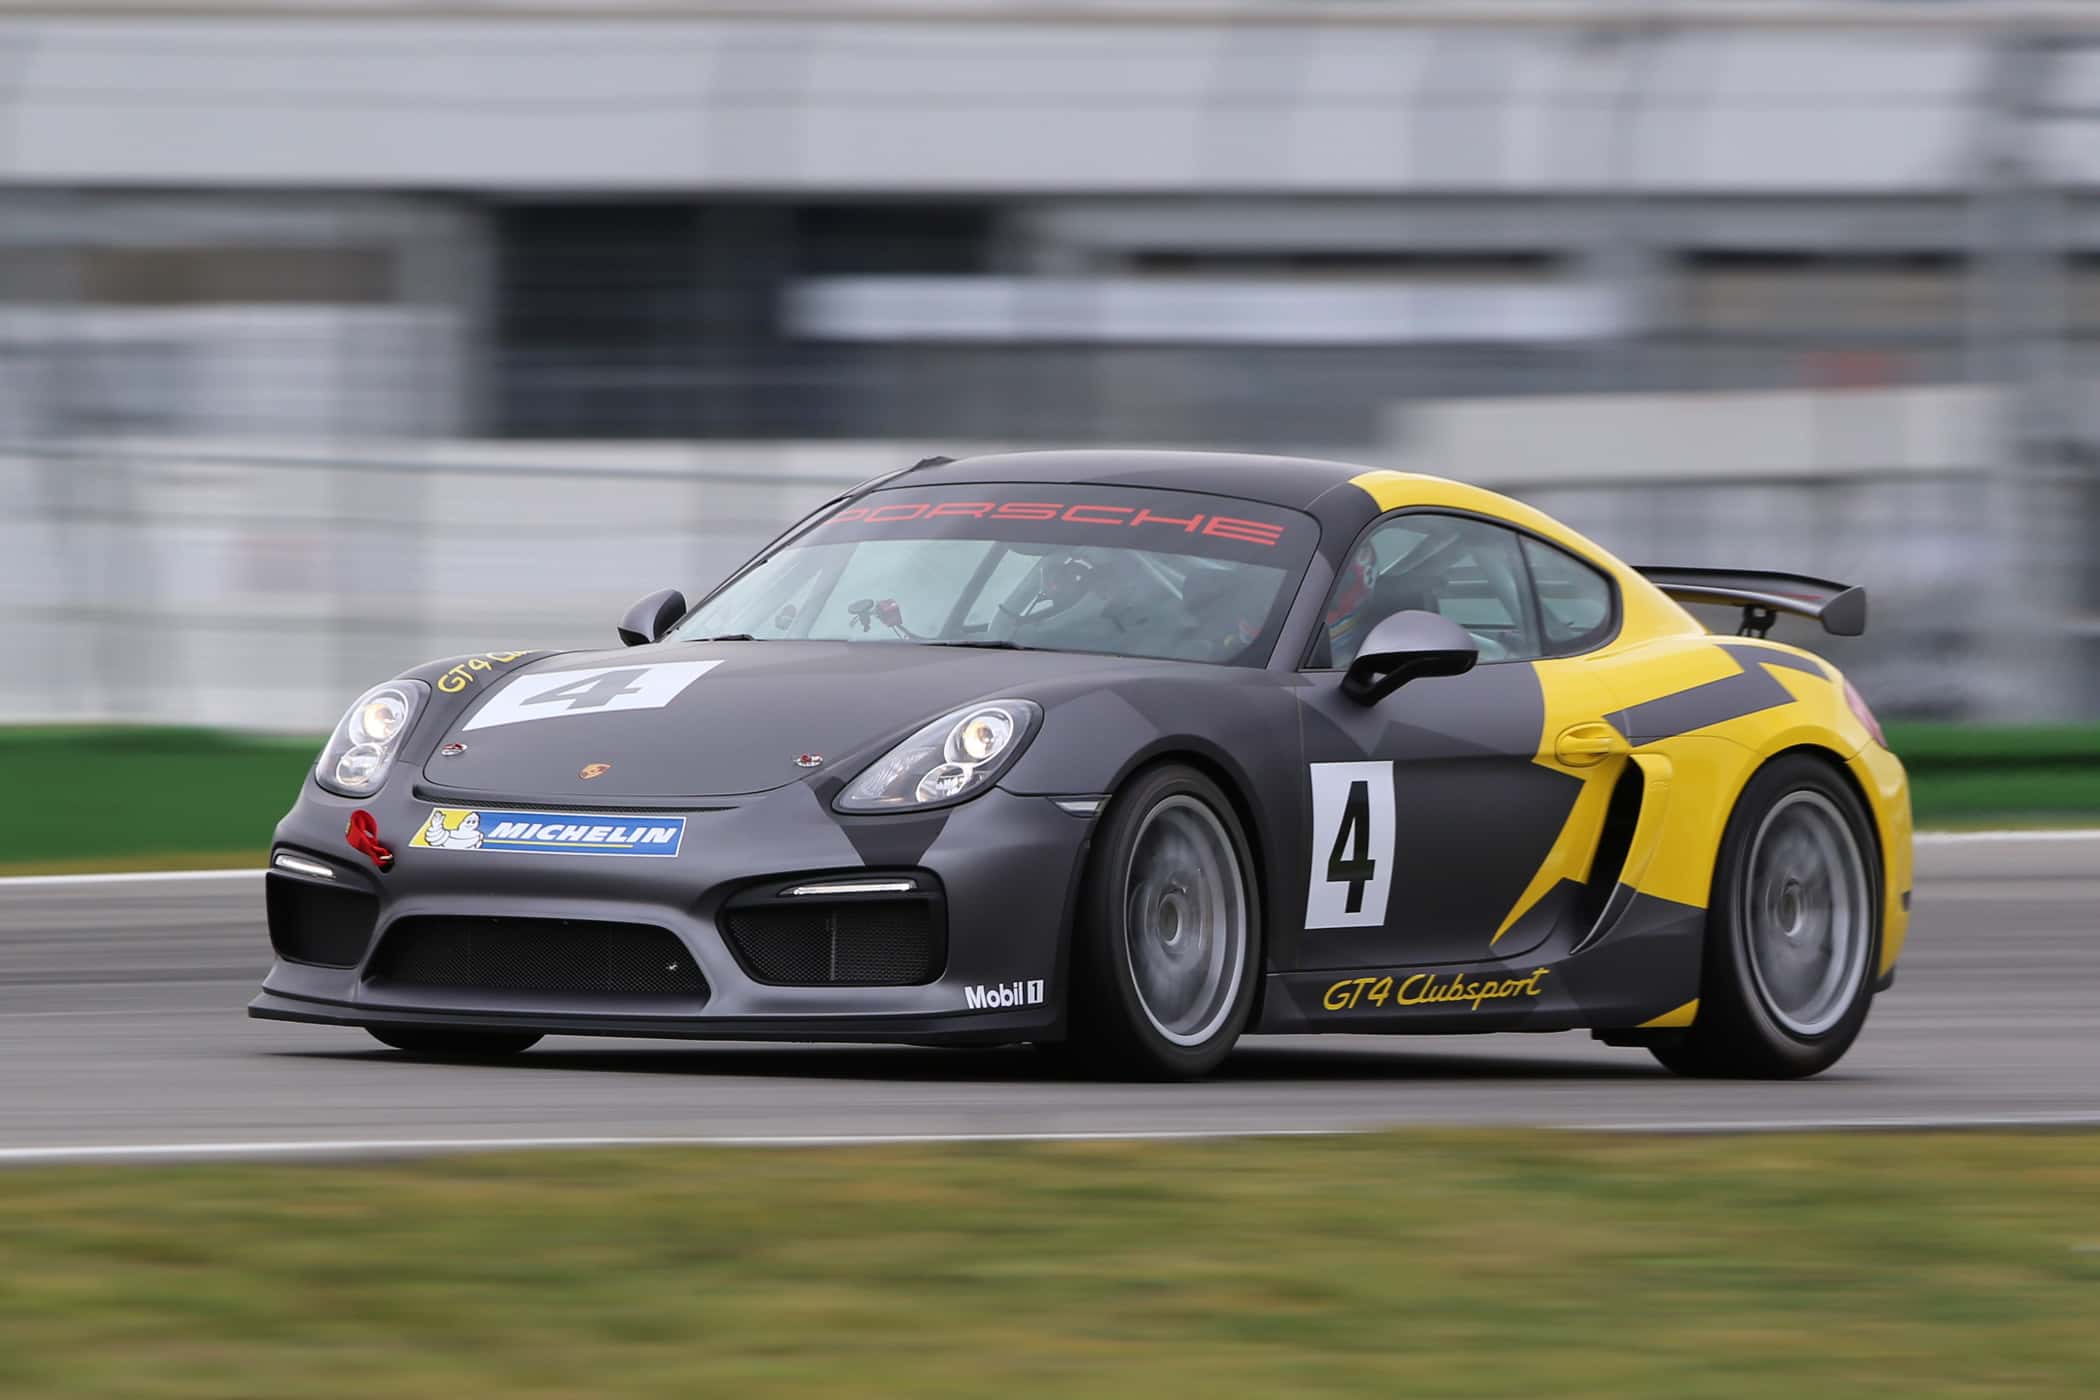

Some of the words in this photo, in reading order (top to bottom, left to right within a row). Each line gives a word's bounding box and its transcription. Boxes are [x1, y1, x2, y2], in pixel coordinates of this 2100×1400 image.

[822, 502, 1285, 546] PORSCHE
[437, 657, 493, 693] GT4
[518, 667, 653, 711] 4
[488, 821, 678, 844] MICHELIN
[1325, 779, 1377, 914] 4
[964, 981, 1024, 1009] Mobil
[1322, 975, 1393, 1011] GT4
[1396, 967, 1550, 1011] Clubsport
